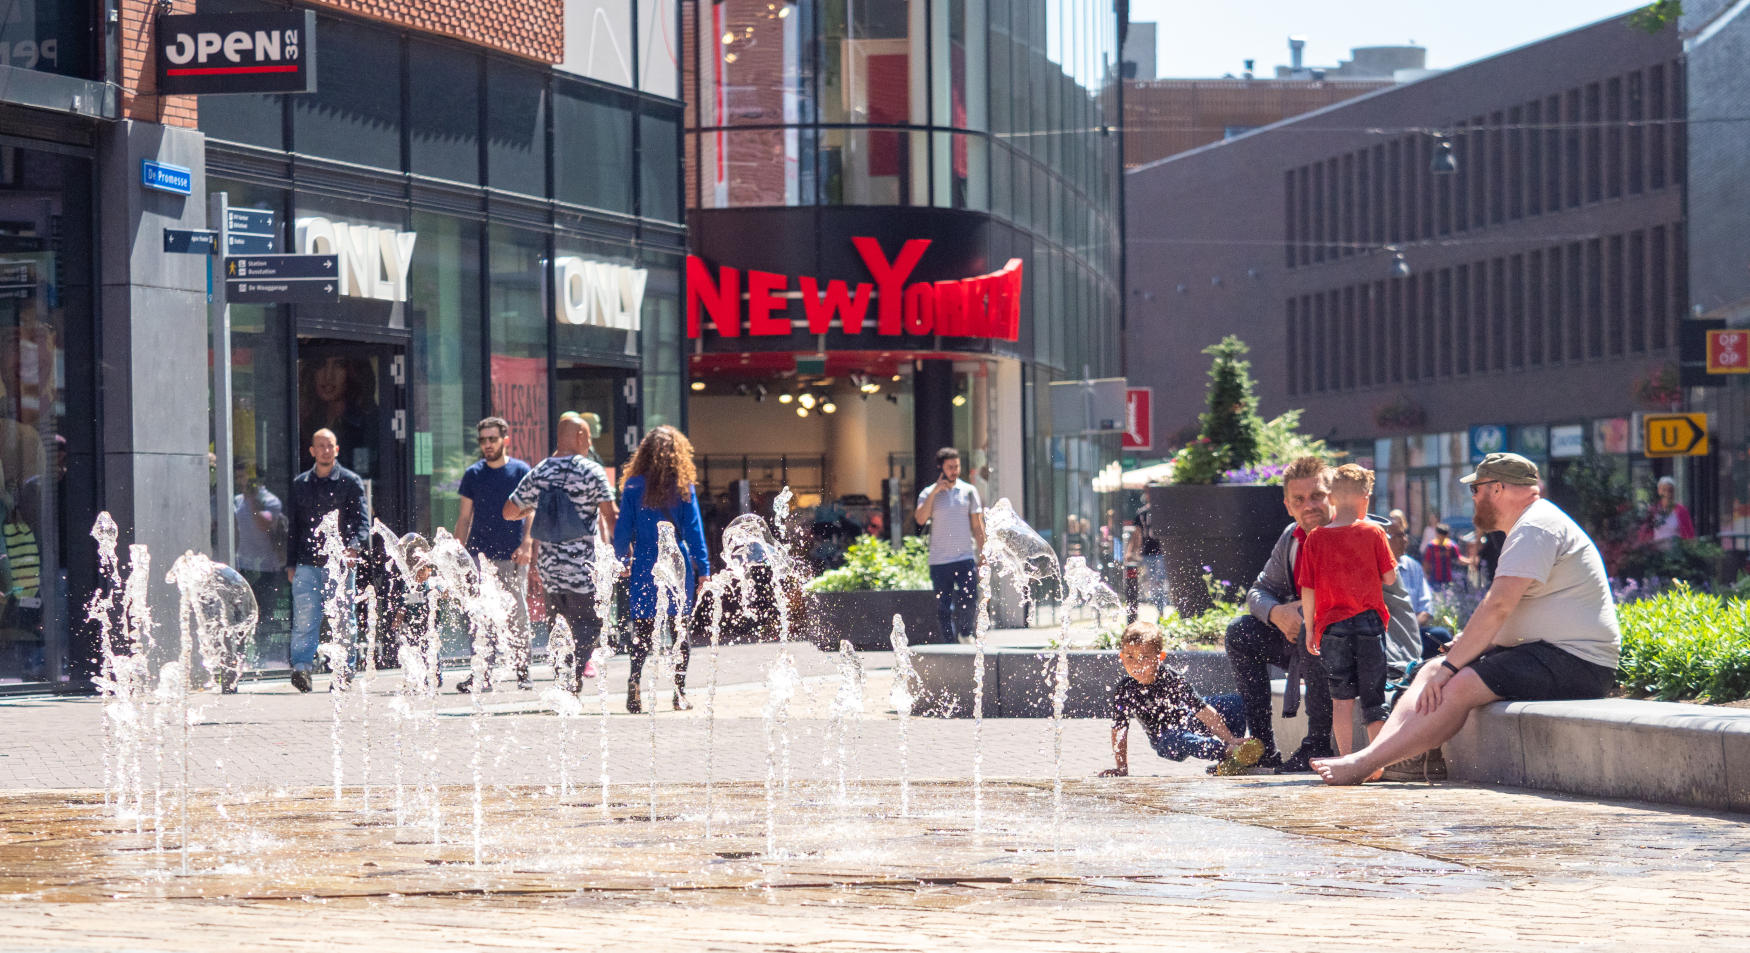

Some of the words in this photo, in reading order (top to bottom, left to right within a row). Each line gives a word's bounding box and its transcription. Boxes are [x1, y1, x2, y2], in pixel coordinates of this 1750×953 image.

[284, 29, 299, 60] 32
[148, 168, 157, 181] De
[158, 170, 188, 188] Promesse
[555, 256, 648, 331] ONLY
[1660, 426, 1678, 448] U
